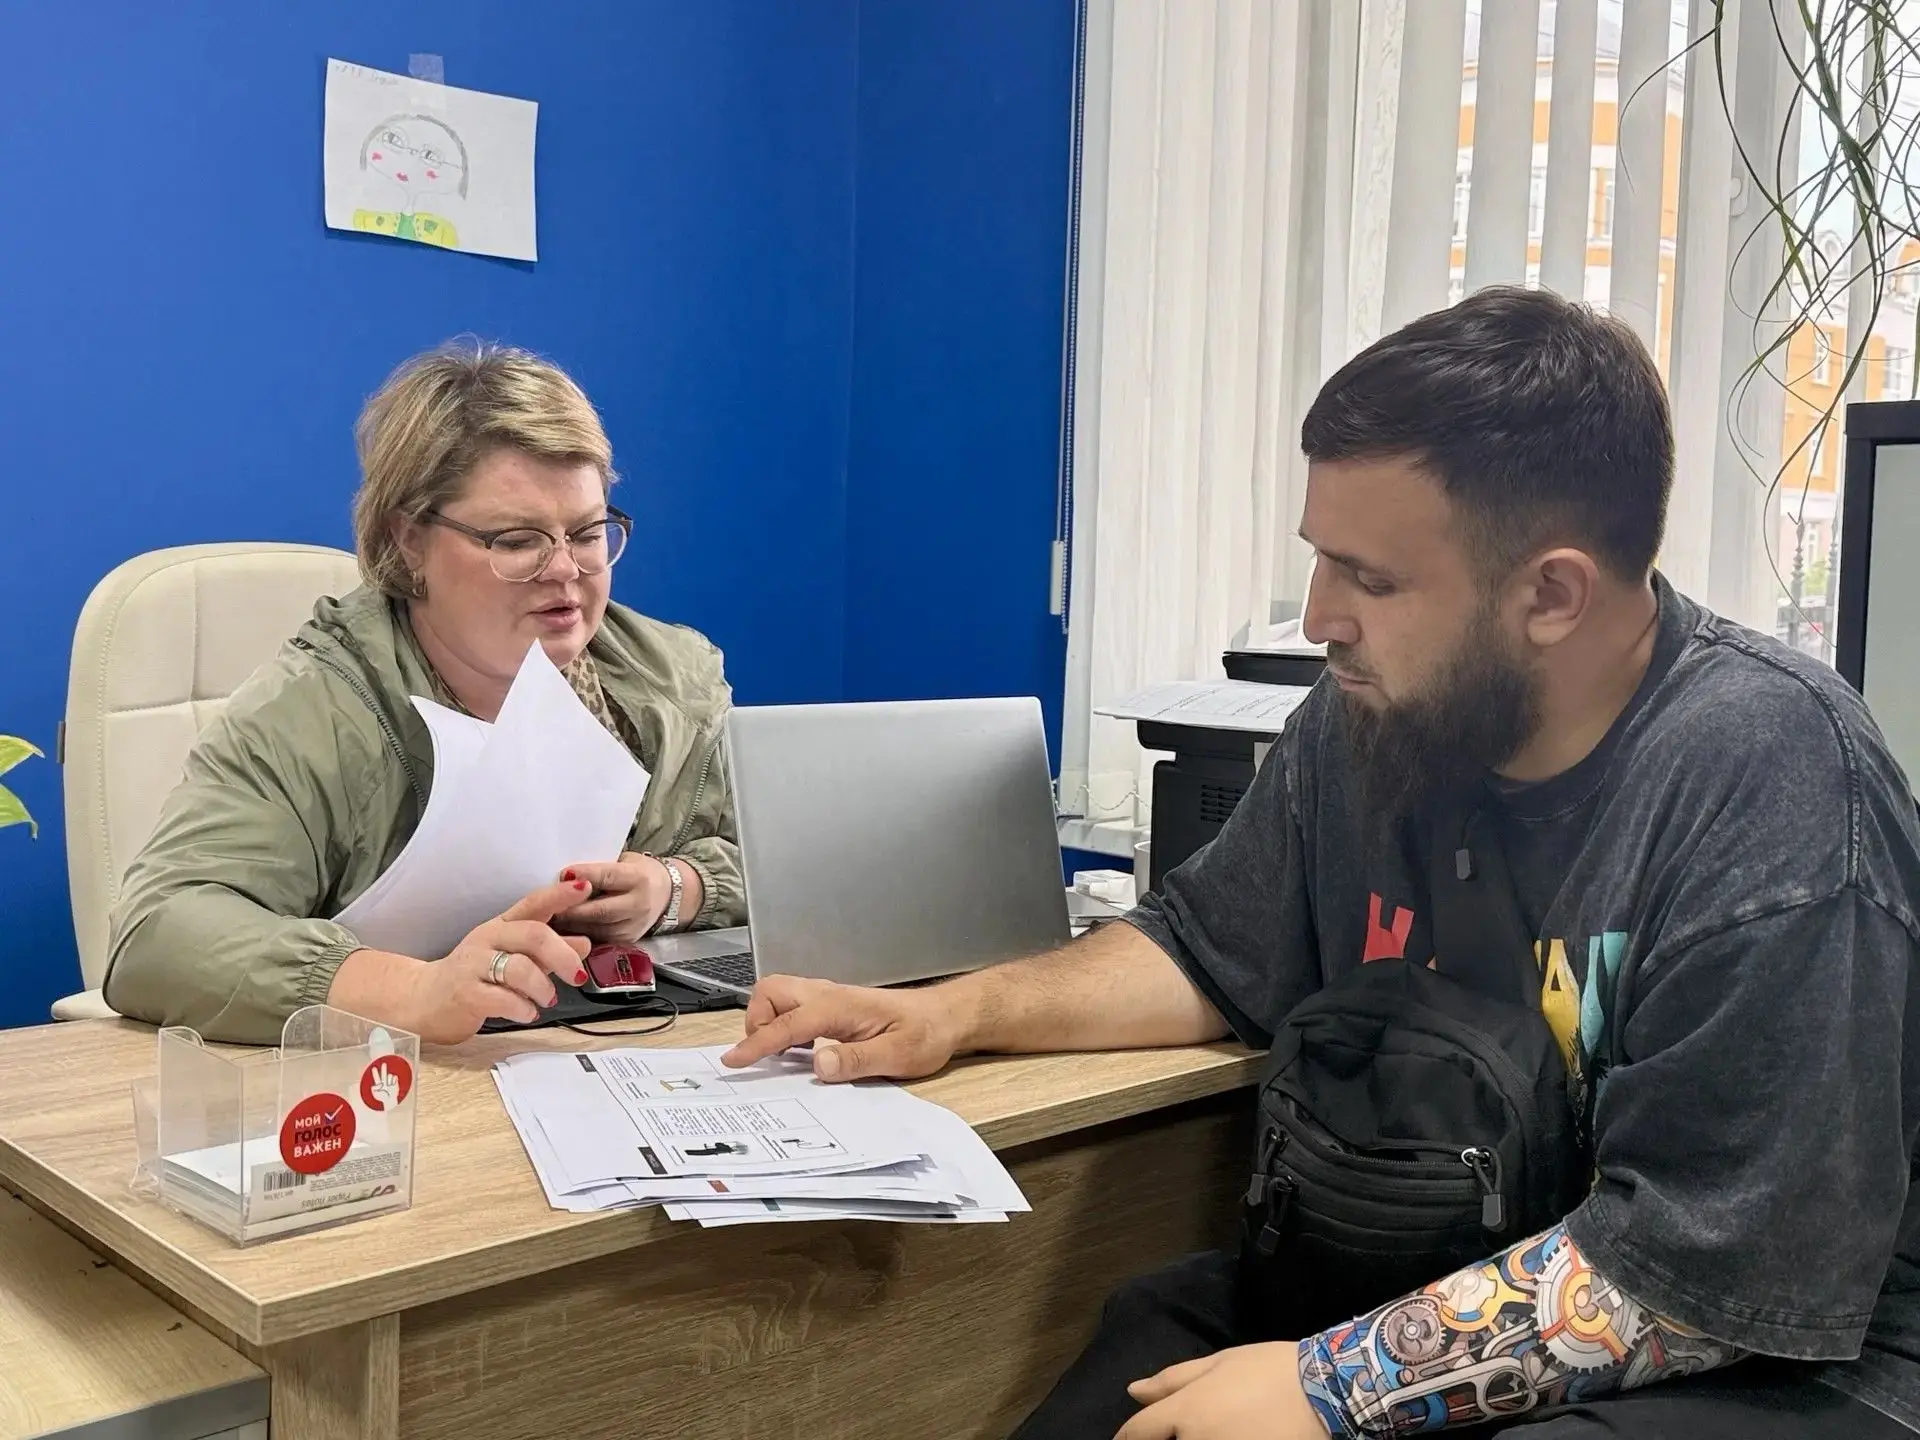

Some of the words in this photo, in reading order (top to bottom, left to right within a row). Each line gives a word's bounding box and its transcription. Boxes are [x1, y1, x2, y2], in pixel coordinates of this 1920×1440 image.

[295, 1113, 321, 1129] МОЙ
[295, 1123, 342, 1145] ГОЛОС
[293, 1138, 342, 1158] ВАЖЕН
